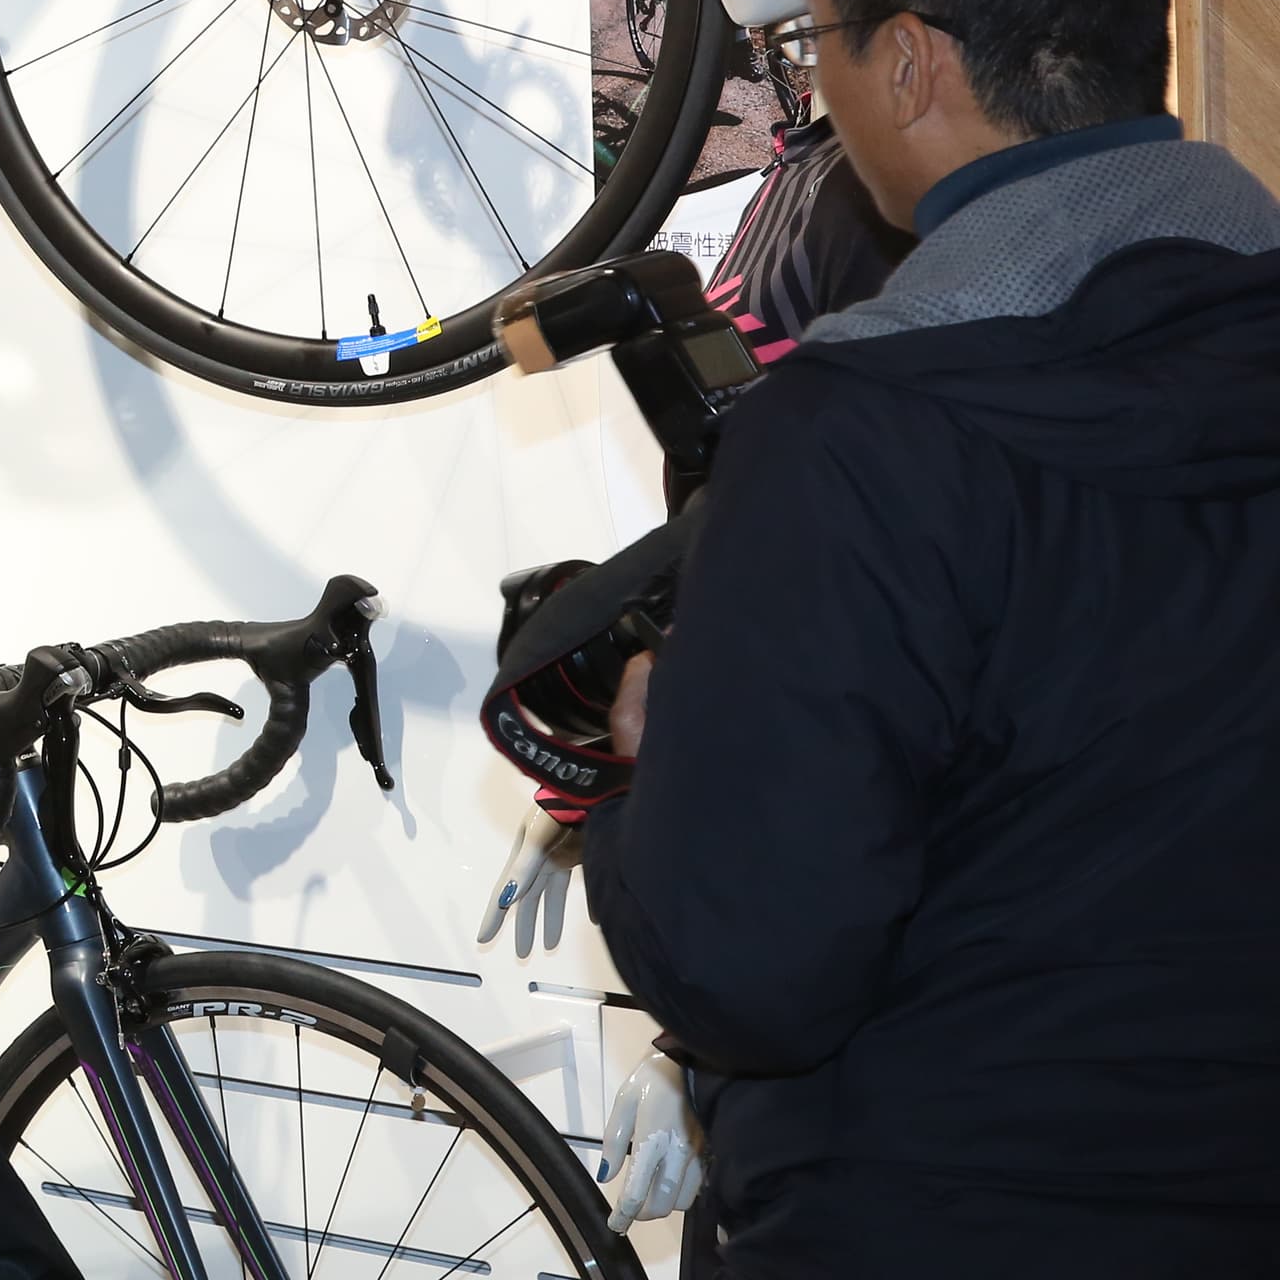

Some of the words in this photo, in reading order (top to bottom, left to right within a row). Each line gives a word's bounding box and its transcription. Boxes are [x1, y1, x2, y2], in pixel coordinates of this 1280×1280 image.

[450, 343, 504, 376] IANT
[288, 381, 327, 398] SLR
[325, 380, 385, 398] GAVIA
[497, 710, 599, 788] Canon
[192, 1001, 318, 1029] PR-2
